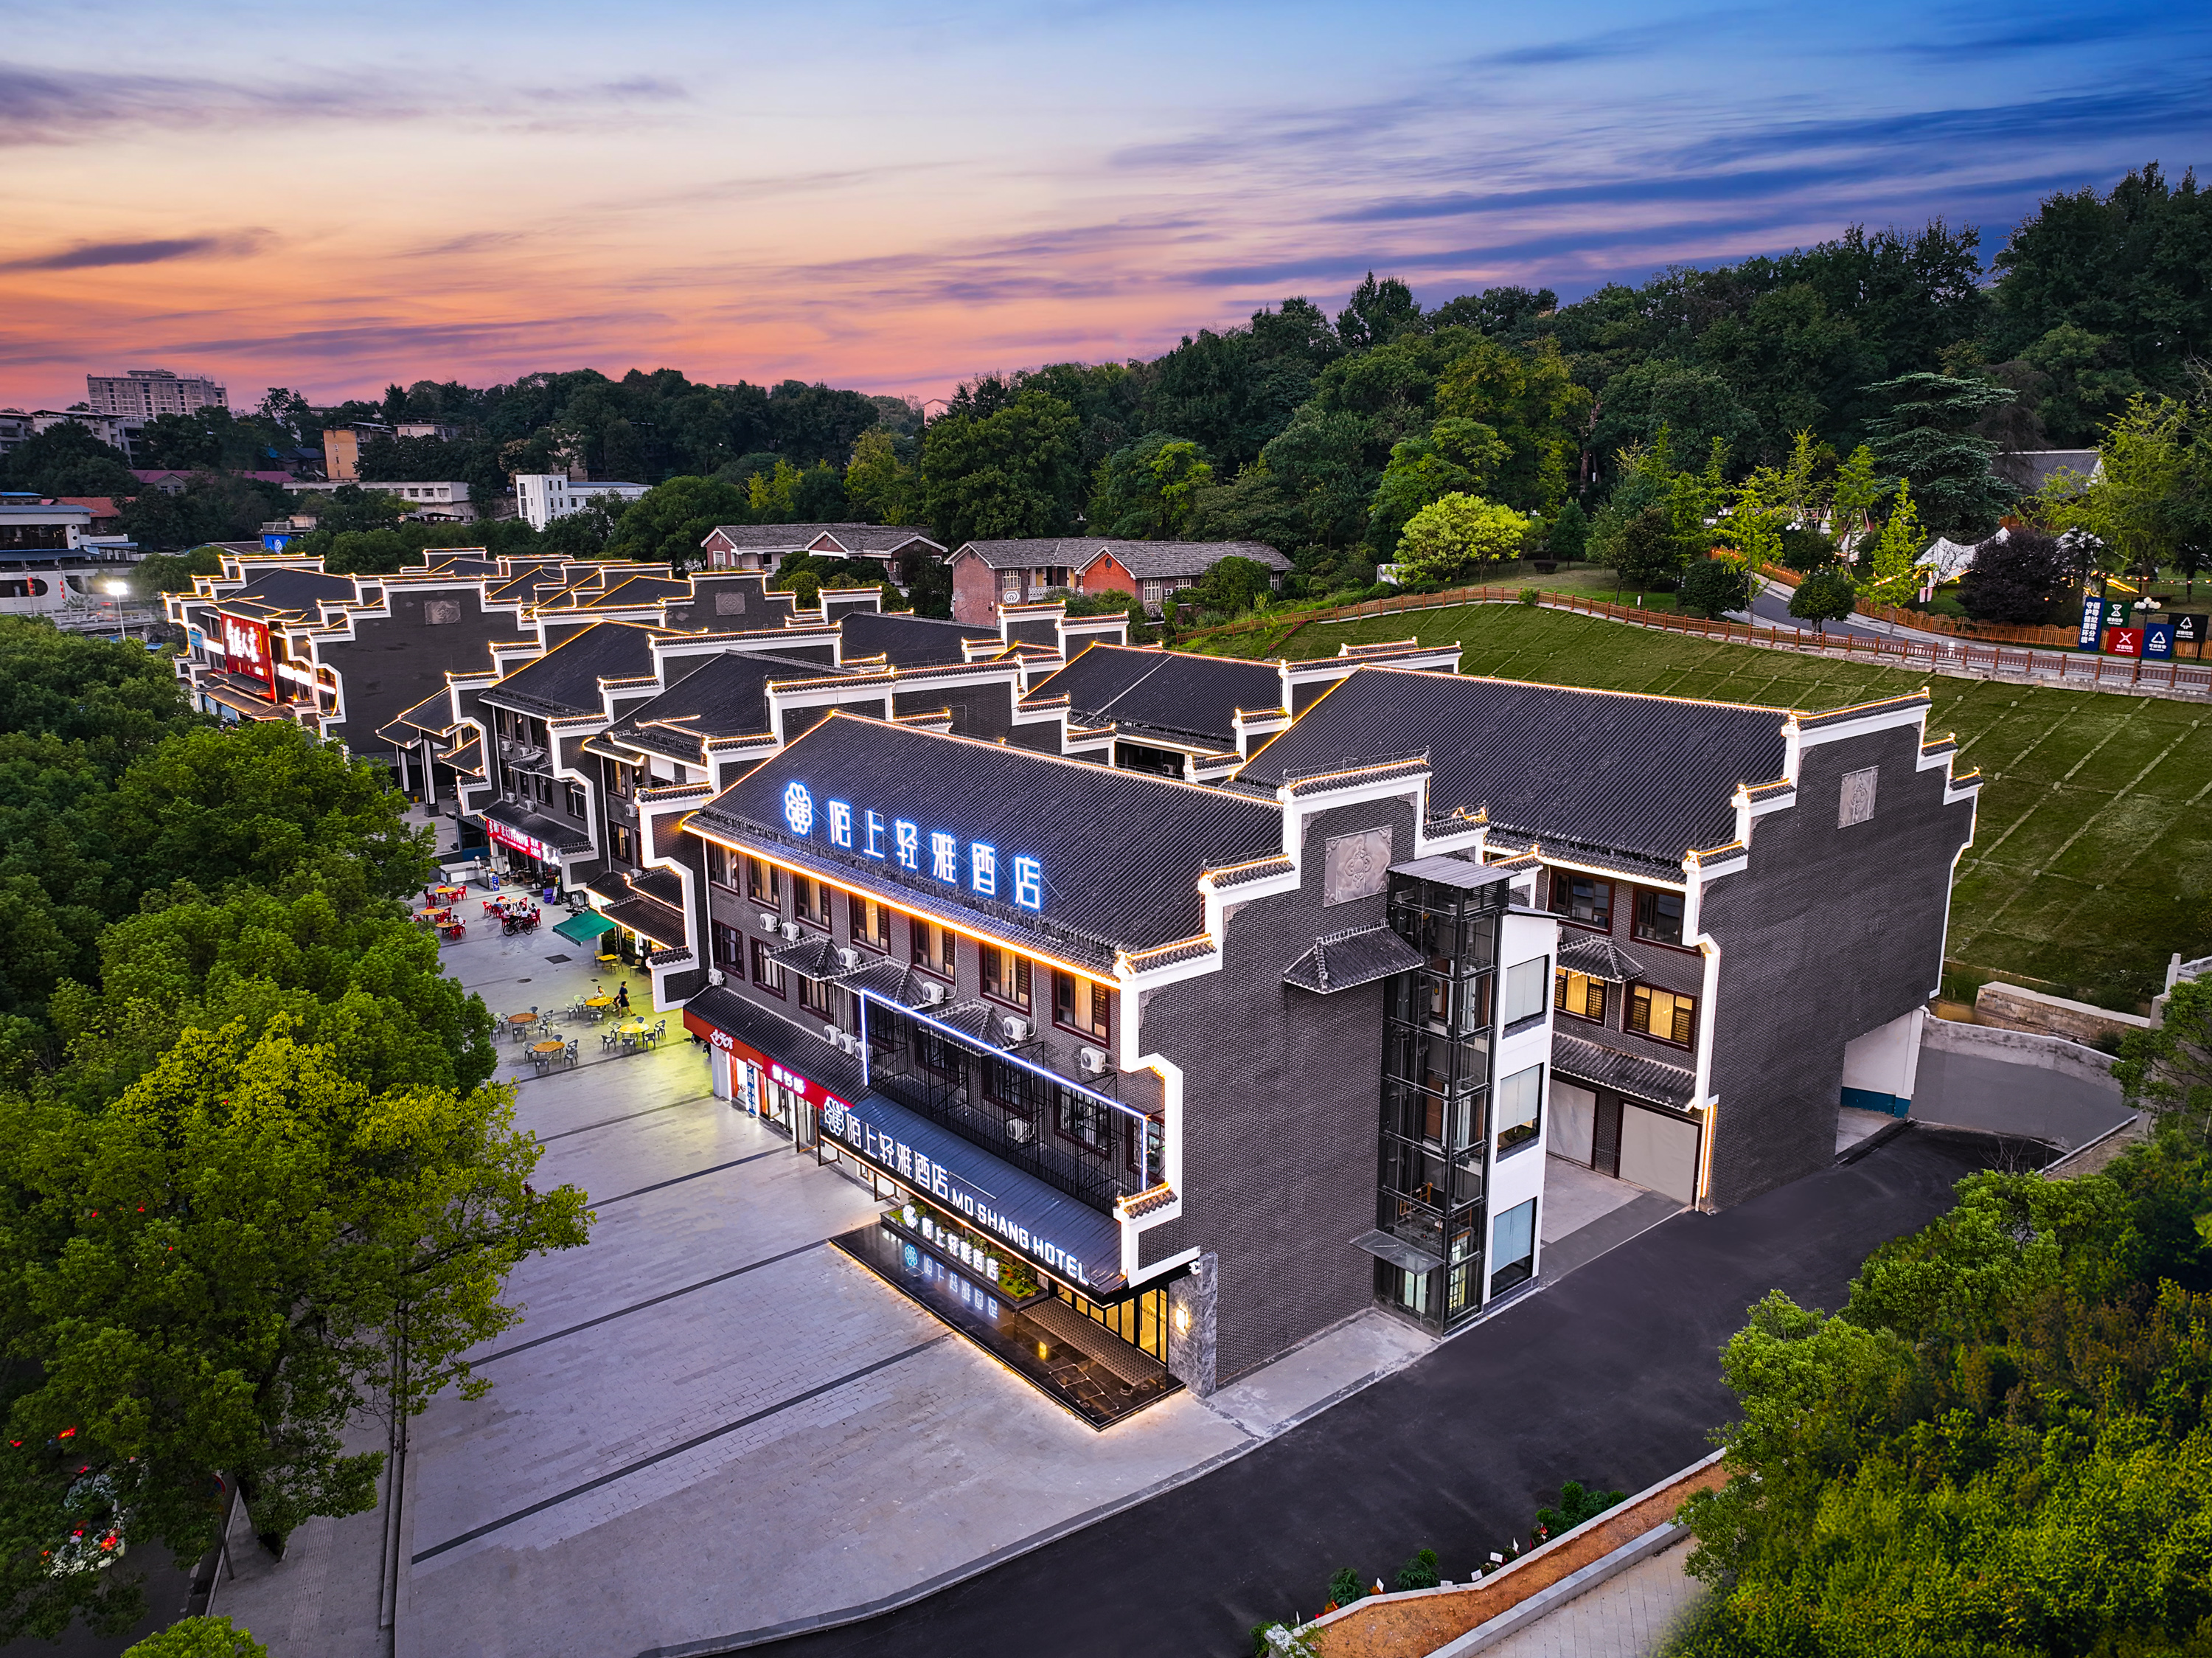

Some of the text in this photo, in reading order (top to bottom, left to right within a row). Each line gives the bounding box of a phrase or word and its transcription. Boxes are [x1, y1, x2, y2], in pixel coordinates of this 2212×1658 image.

[829, 800, 1040, 909] 陌上轻雅酒店
[846, 1113, 949, 1201] 陌上轻雅酒店
[922, 1217, 999, 1282] 陌上轻雅酒店
[952, 1187, 1090, 1286] MO SHANG HOTEL
